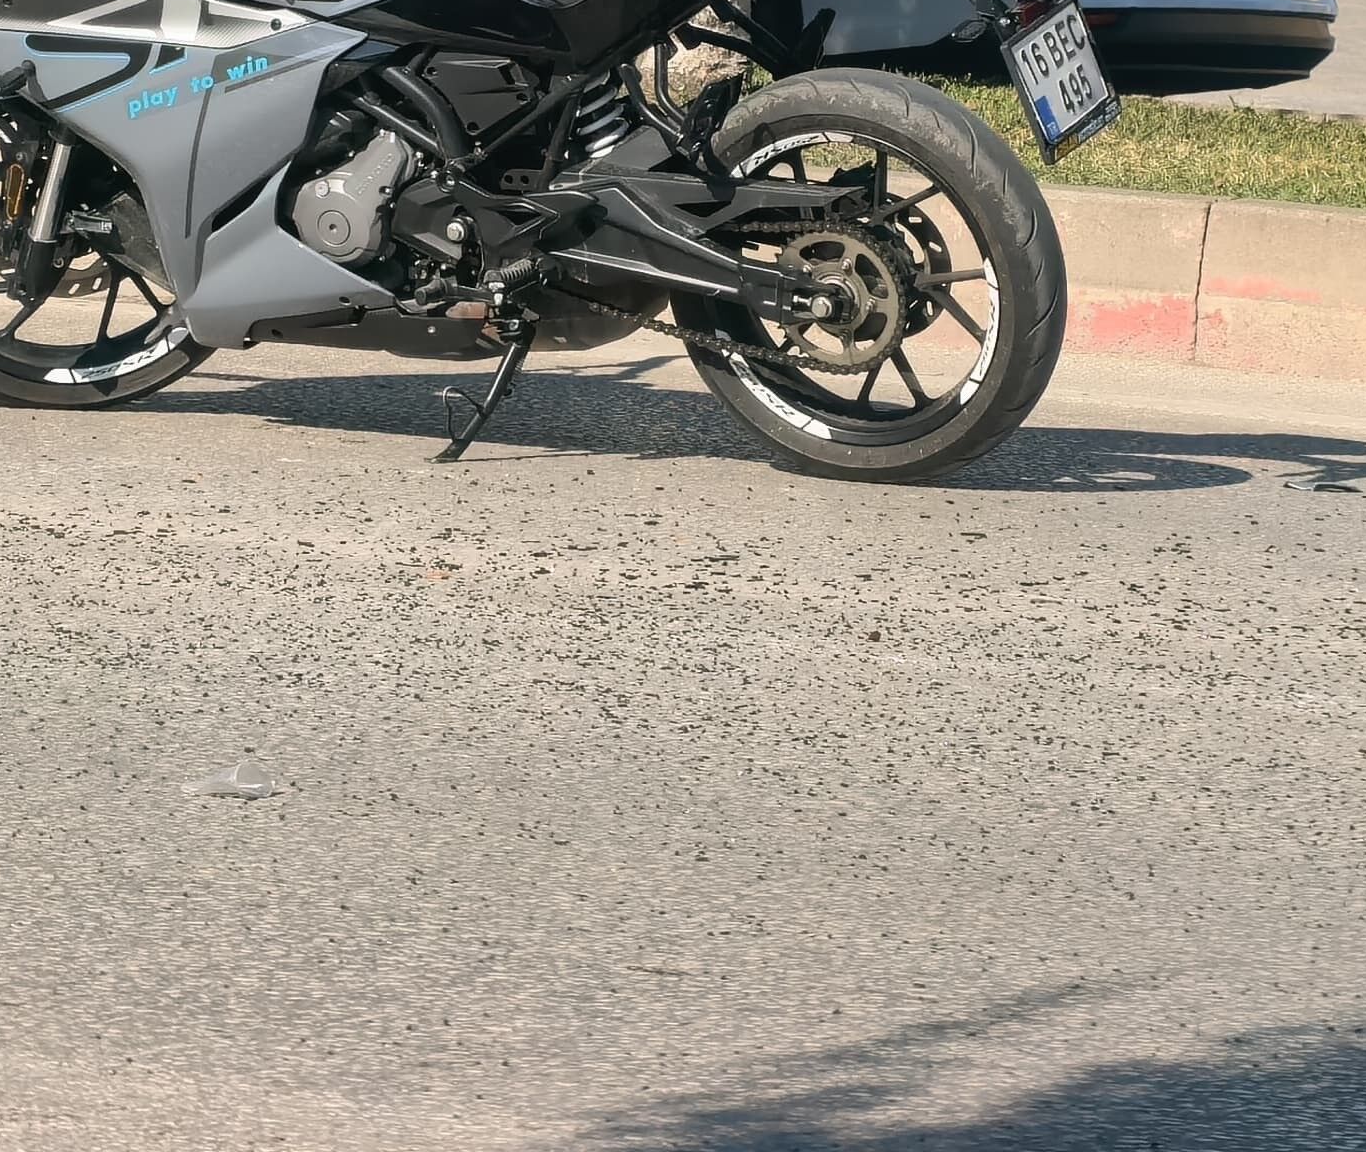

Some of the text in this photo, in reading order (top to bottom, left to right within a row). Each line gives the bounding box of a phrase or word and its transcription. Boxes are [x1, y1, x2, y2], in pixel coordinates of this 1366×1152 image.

[1021, 14, 1085, 85] 16 BEC
[128, 55, 269, 119] play to win
[1059, 64, 1093, 115] 495
